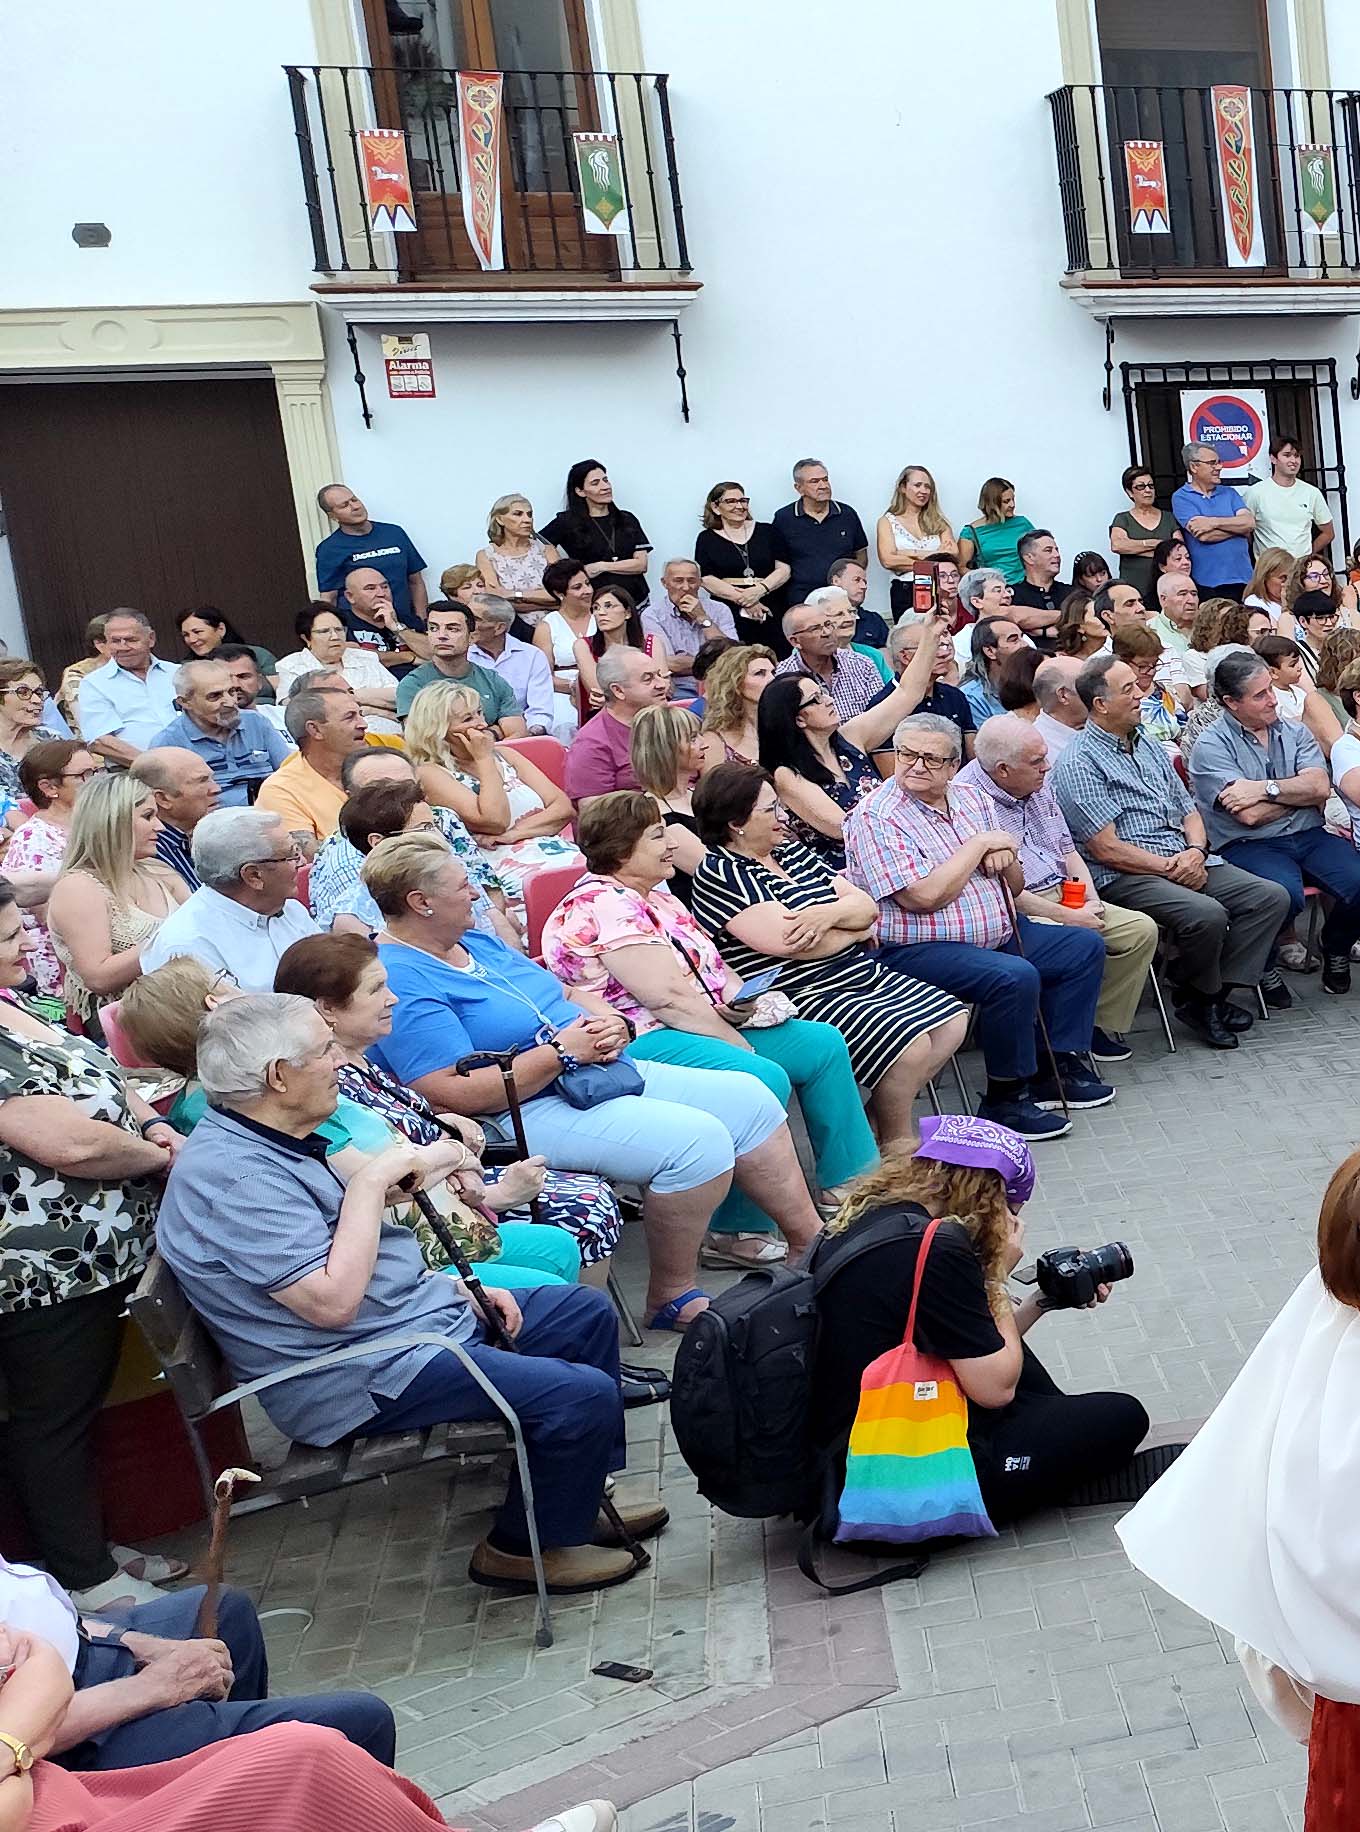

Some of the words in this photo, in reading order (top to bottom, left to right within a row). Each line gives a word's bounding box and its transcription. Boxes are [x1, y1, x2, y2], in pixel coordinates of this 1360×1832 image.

[388, 360, 430, 370] Alarma
[1202, 425, 1249, 434] PROHIBIDO
[1200, 432, 1253, 442] ESTACIONAR
